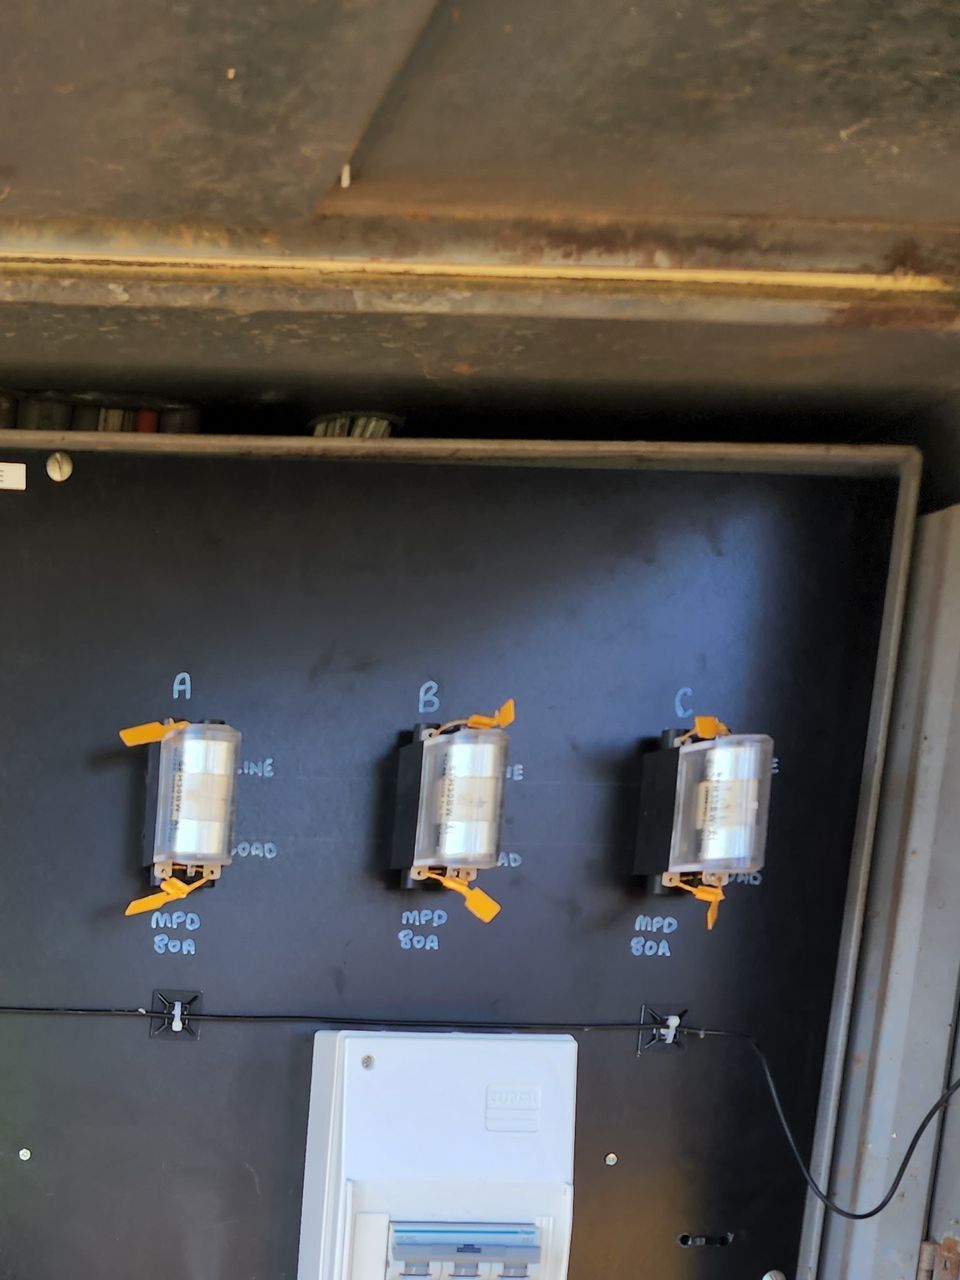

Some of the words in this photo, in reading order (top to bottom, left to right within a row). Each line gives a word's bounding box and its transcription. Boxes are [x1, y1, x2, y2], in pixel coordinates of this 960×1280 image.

[173, 672, 191, 699] A
[418, 680, 441, 713] B
[675, 687, 693, 718] C
[237, 757, 275, 778] INE
[231, 841, 277, 859] OAD
[150, 911, 201, 930] MPD
[401, 909, 448, 927] MPD
[634, 915, 678, 934] MPD
[153, 933, 196, 955] 80A
[398, 929, 439, 950] 80A
[630, 937, 671, 957] 80A
